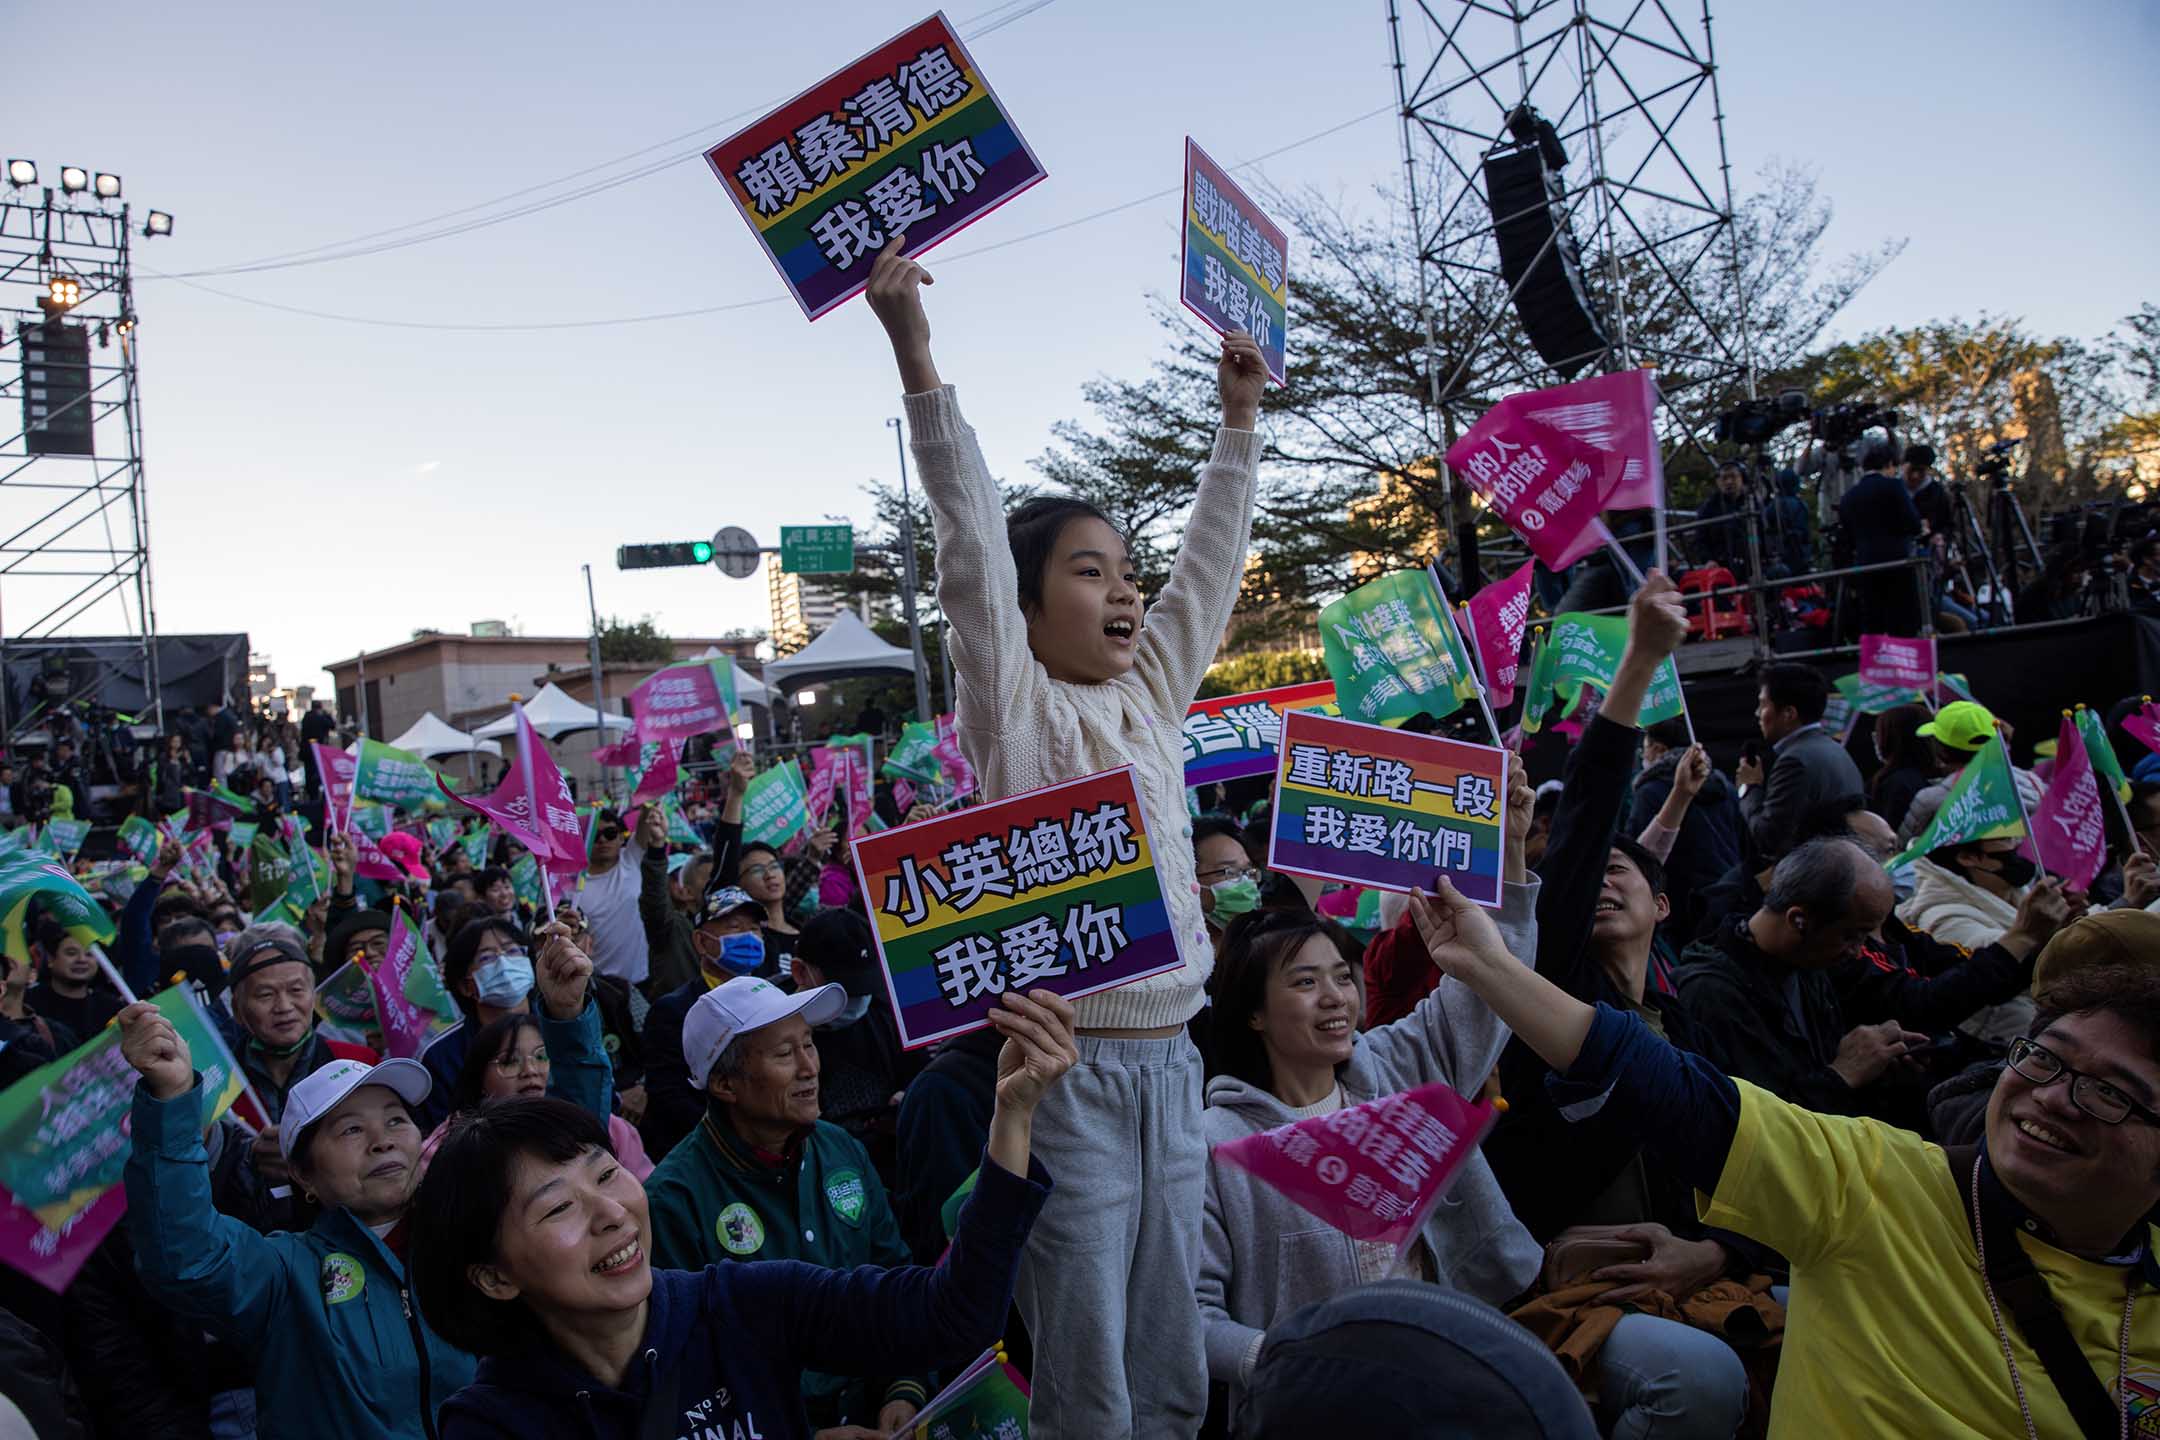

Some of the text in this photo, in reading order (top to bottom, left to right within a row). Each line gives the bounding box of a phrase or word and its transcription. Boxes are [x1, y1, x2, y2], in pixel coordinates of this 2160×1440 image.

[737, 47, 969, 215] 賴桑清德
[813, 139, 986, 270] 我愛你
[1194, 169, 1282, 293] 戰喵美琴
[1204, 253, 1271, 346] 我愛你
[1288, 745, 1498, 819] 重新路一段
[885, 805, 1137, 923] 小英總統
[1305, 805, 1472, 872] 我愛你們
[935, 904, 1129, 1007] 我愛你
